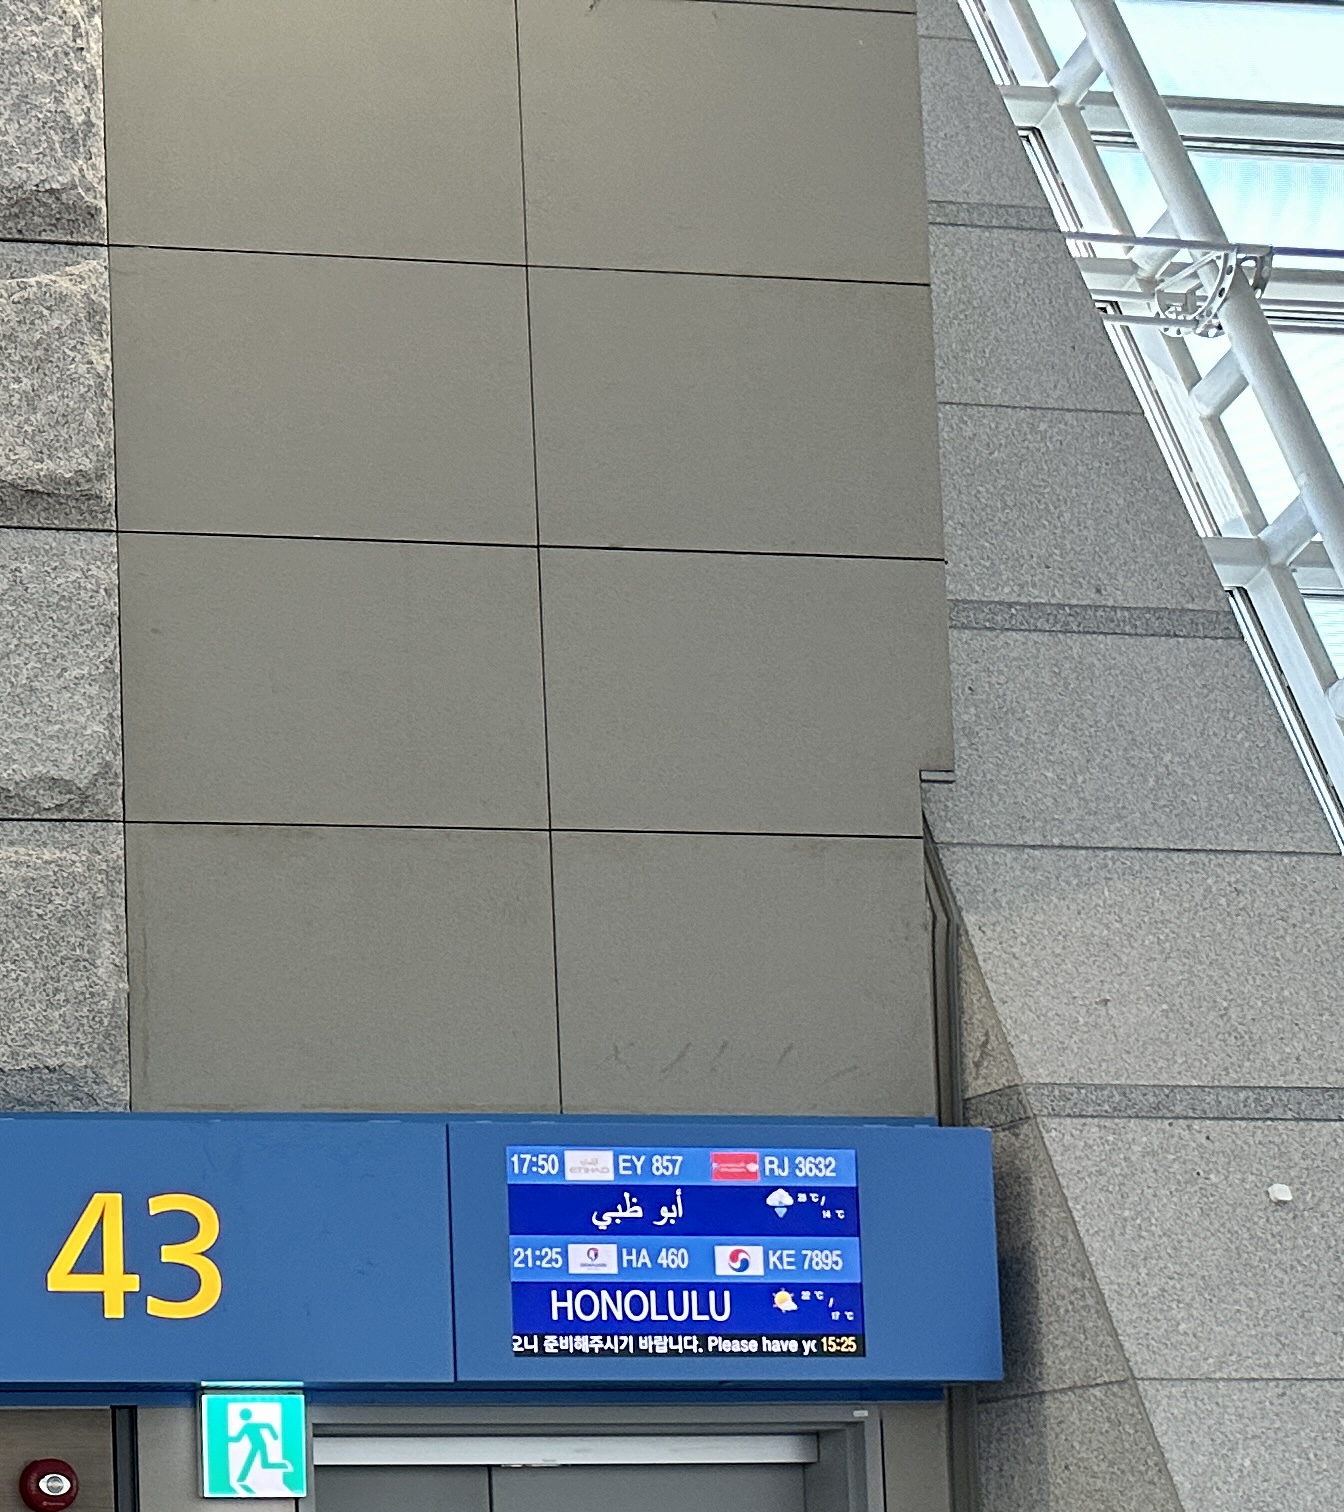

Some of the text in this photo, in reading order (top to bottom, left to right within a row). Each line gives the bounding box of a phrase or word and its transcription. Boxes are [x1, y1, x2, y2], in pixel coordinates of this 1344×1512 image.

[511, 1154, 559, 1175] 17:50
[618, 1155, 645, 1175] EY
[651, 1155, 683, 1176] 857
[764, 1156, 789, 1177] RJ
[795, 1156, 837, 1177] 3632
[46, 1191, 224, 1320] 43
[513, 1247, 843, 1271] 21:25 HA 460 KE 7895
[550, 1289, 731, 1322] HONOLULU
[543, 1335, 634, 1354] 준비해주시기
[707, 1335, 759, 1352] Please
[762, 1336, 799, 1352] have
[821, 1336, 857, 1353] 15:25
